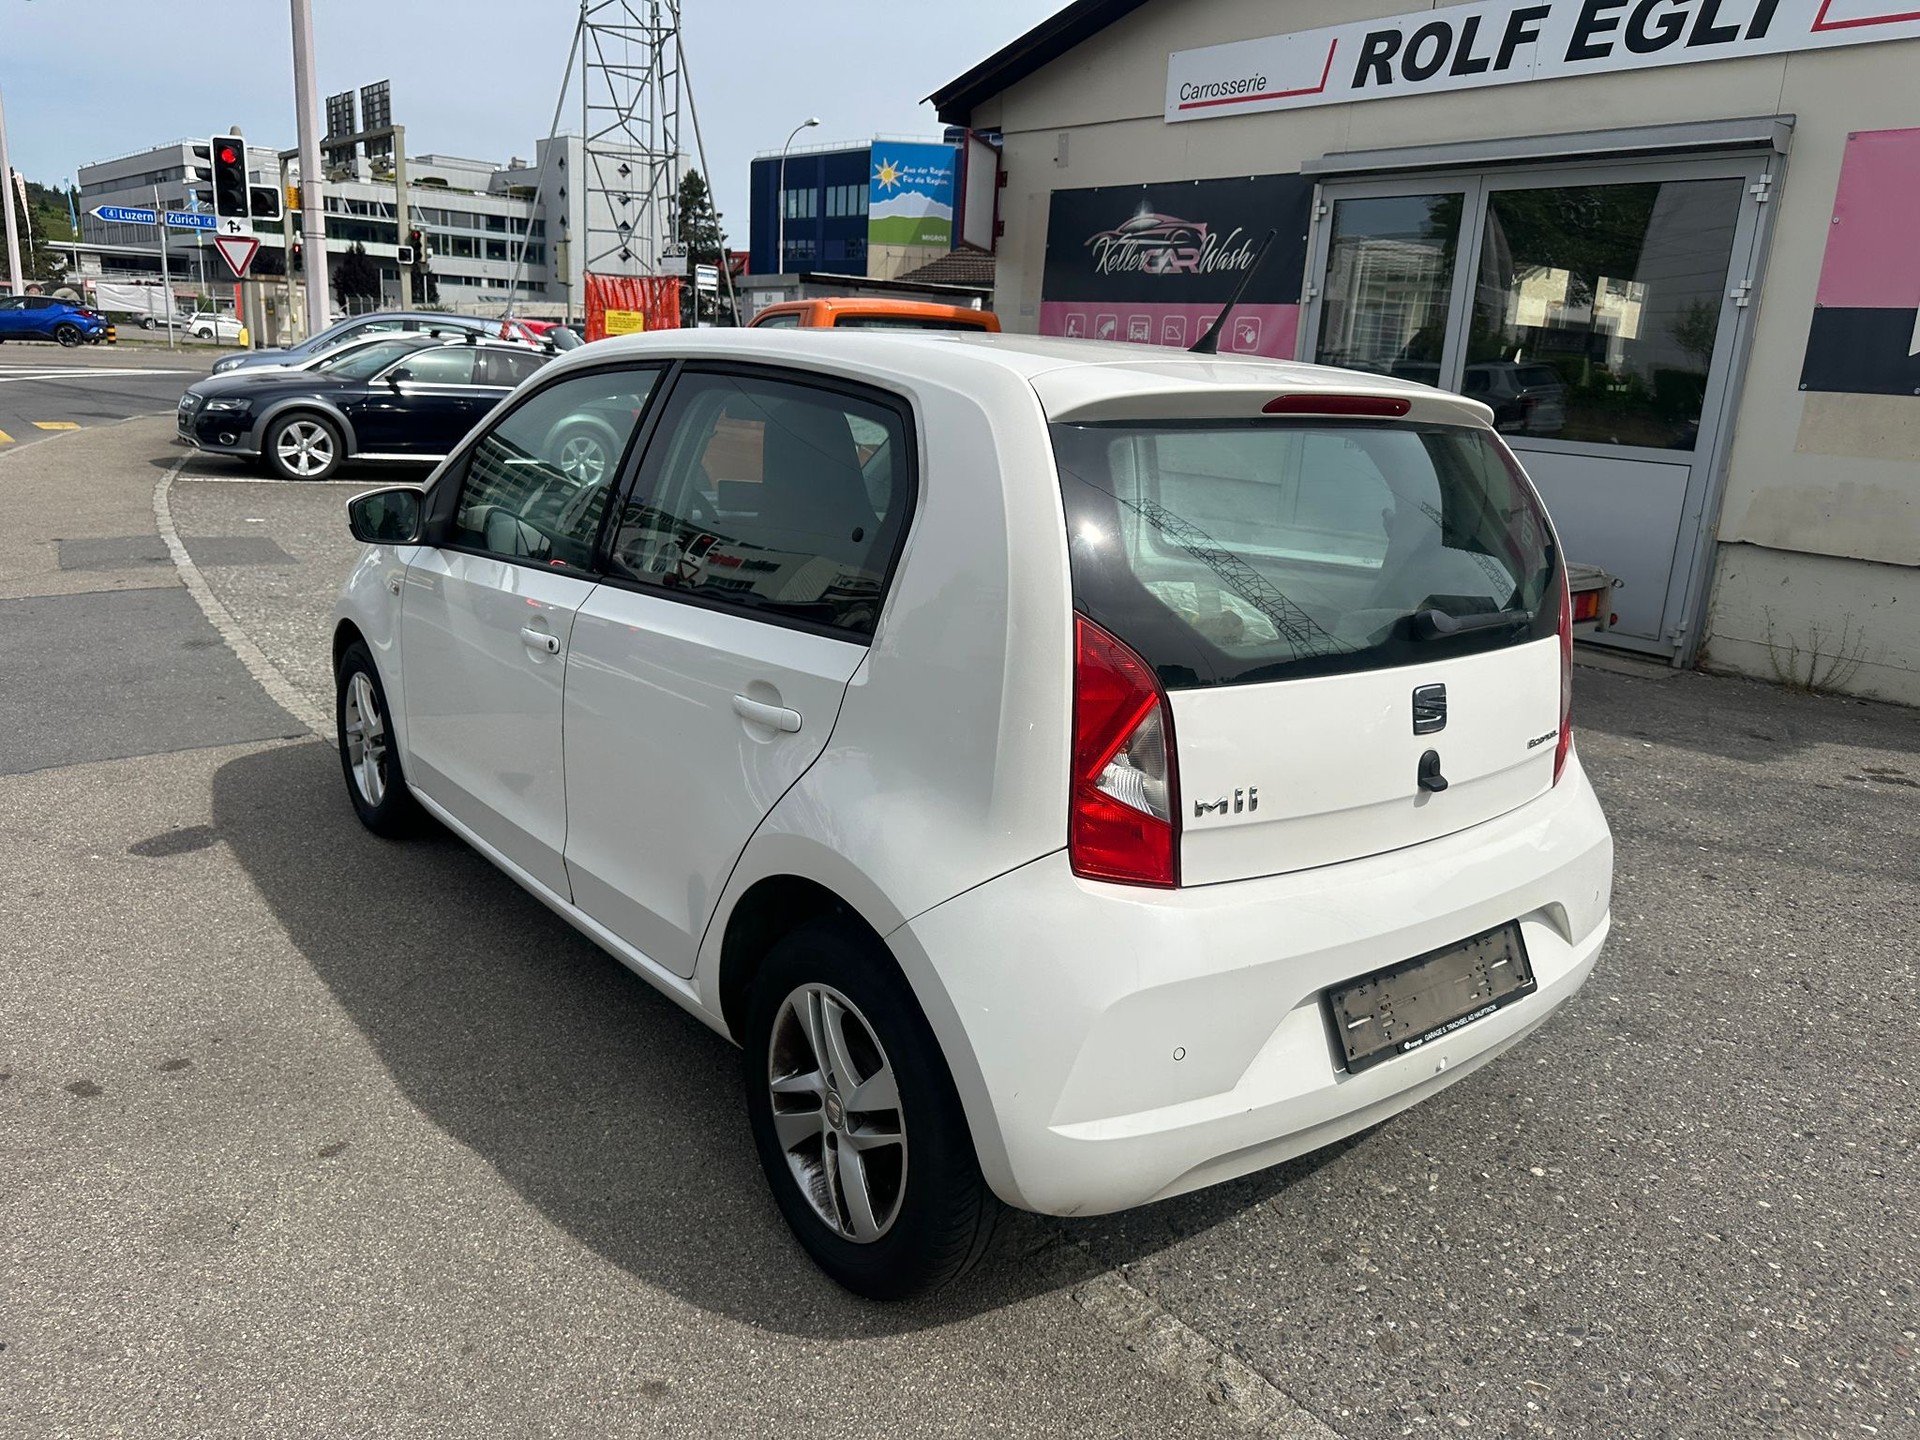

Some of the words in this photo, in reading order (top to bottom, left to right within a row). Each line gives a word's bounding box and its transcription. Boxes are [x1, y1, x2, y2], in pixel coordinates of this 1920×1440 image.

[1351, 4, 1552, 89] ROLF
[1564, 0, 1779, 63] EGLI
[1180, 73, 1267, 101] Carrosserie
[119, 208, 154, 222] Luzern
[168, 213, 200, 226] Zürich
[921, 234, 947, 242] MIGROS
[1093, 233, 1146, 275] Keller
[1143, 248, 1200, 274] CAR
[1200, 227, 1255, 273] Wash
[1424, 1029, 1443, 1041] GARAGE
[1446, 1018, 1469, 1031] TRACHSEL
